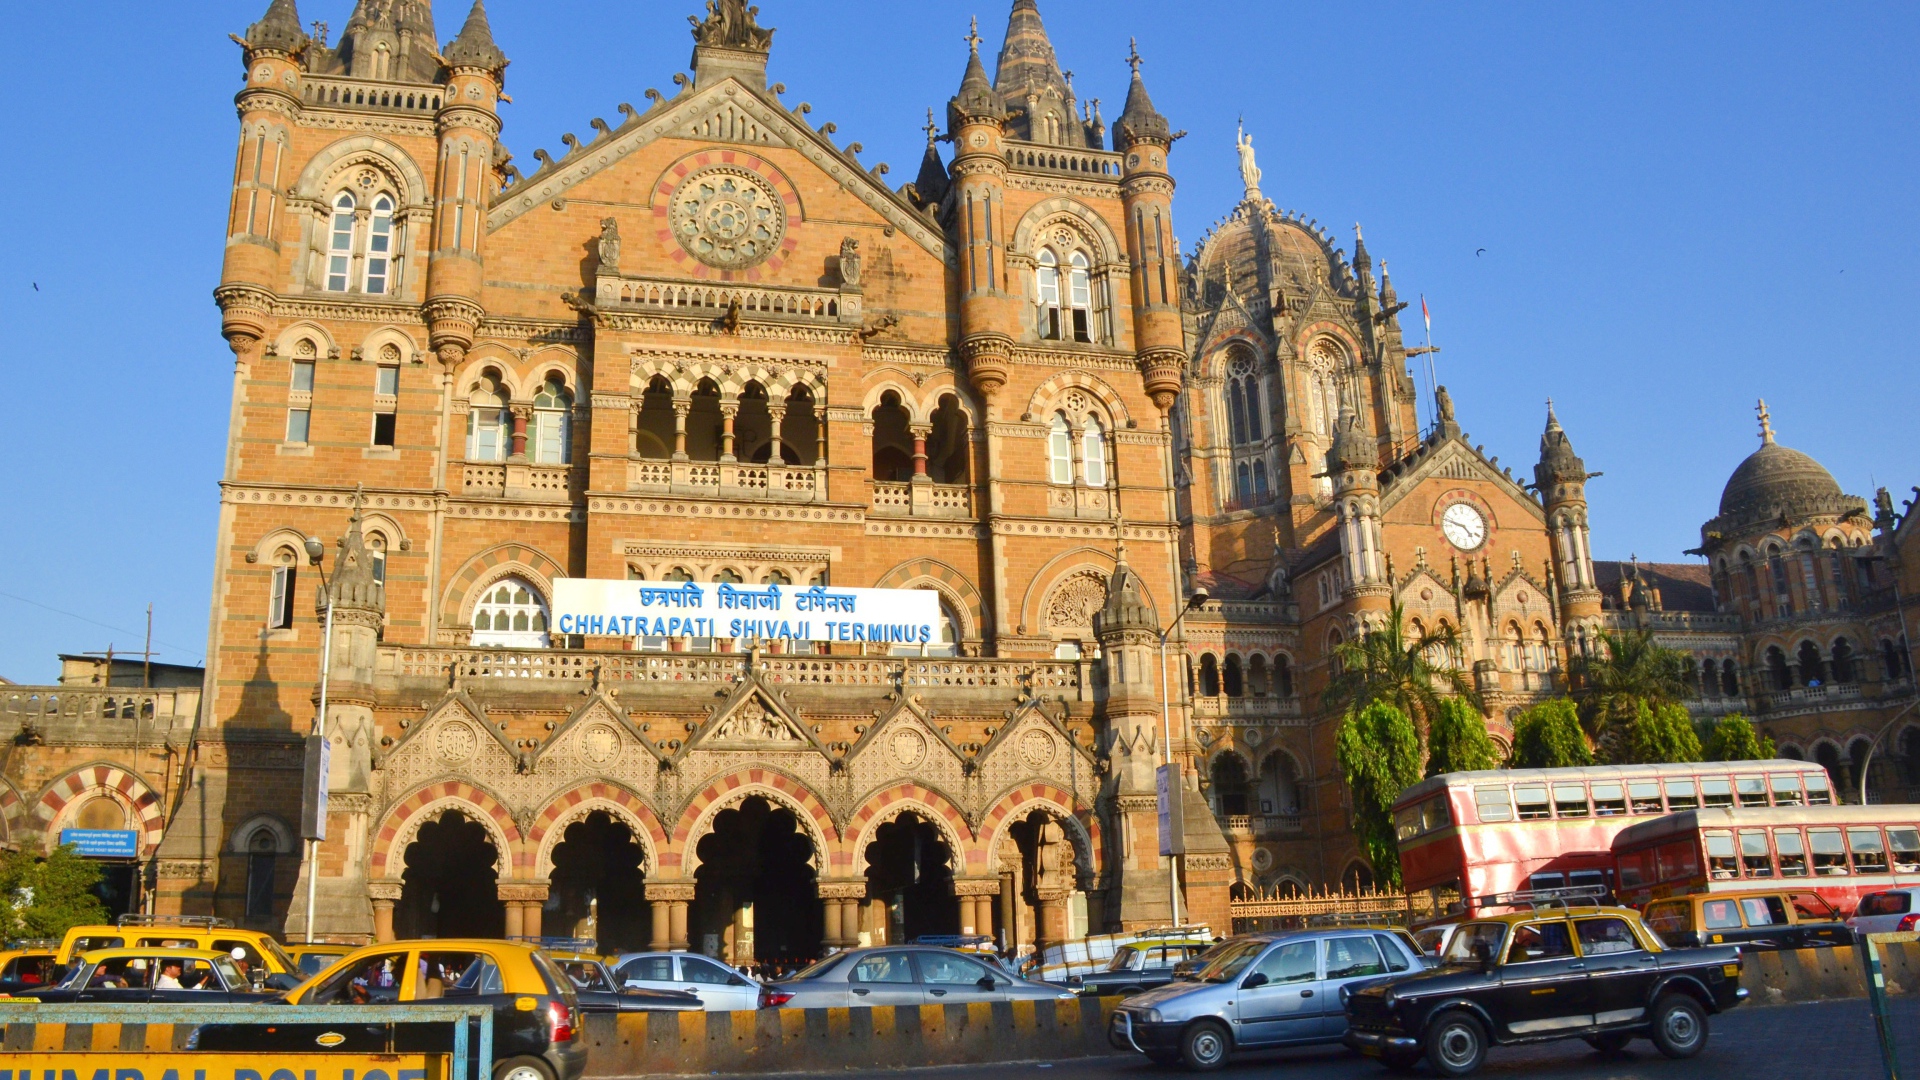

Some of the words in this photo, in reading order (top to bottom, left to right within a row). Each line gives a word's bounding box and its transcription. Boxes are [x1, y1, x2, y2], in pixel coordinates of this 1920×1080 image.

[640, 580, 705, 607] छत्रपति
[718, 582, 782, 611] शिवाजी
[795, 585, 857, 613] टर्मिनस
[559, 613, 715, 638] CHHATRAPATI
[730, 617, 810, 640] SHIVAJI
[826, 621, 931, 643] TERMINUS
